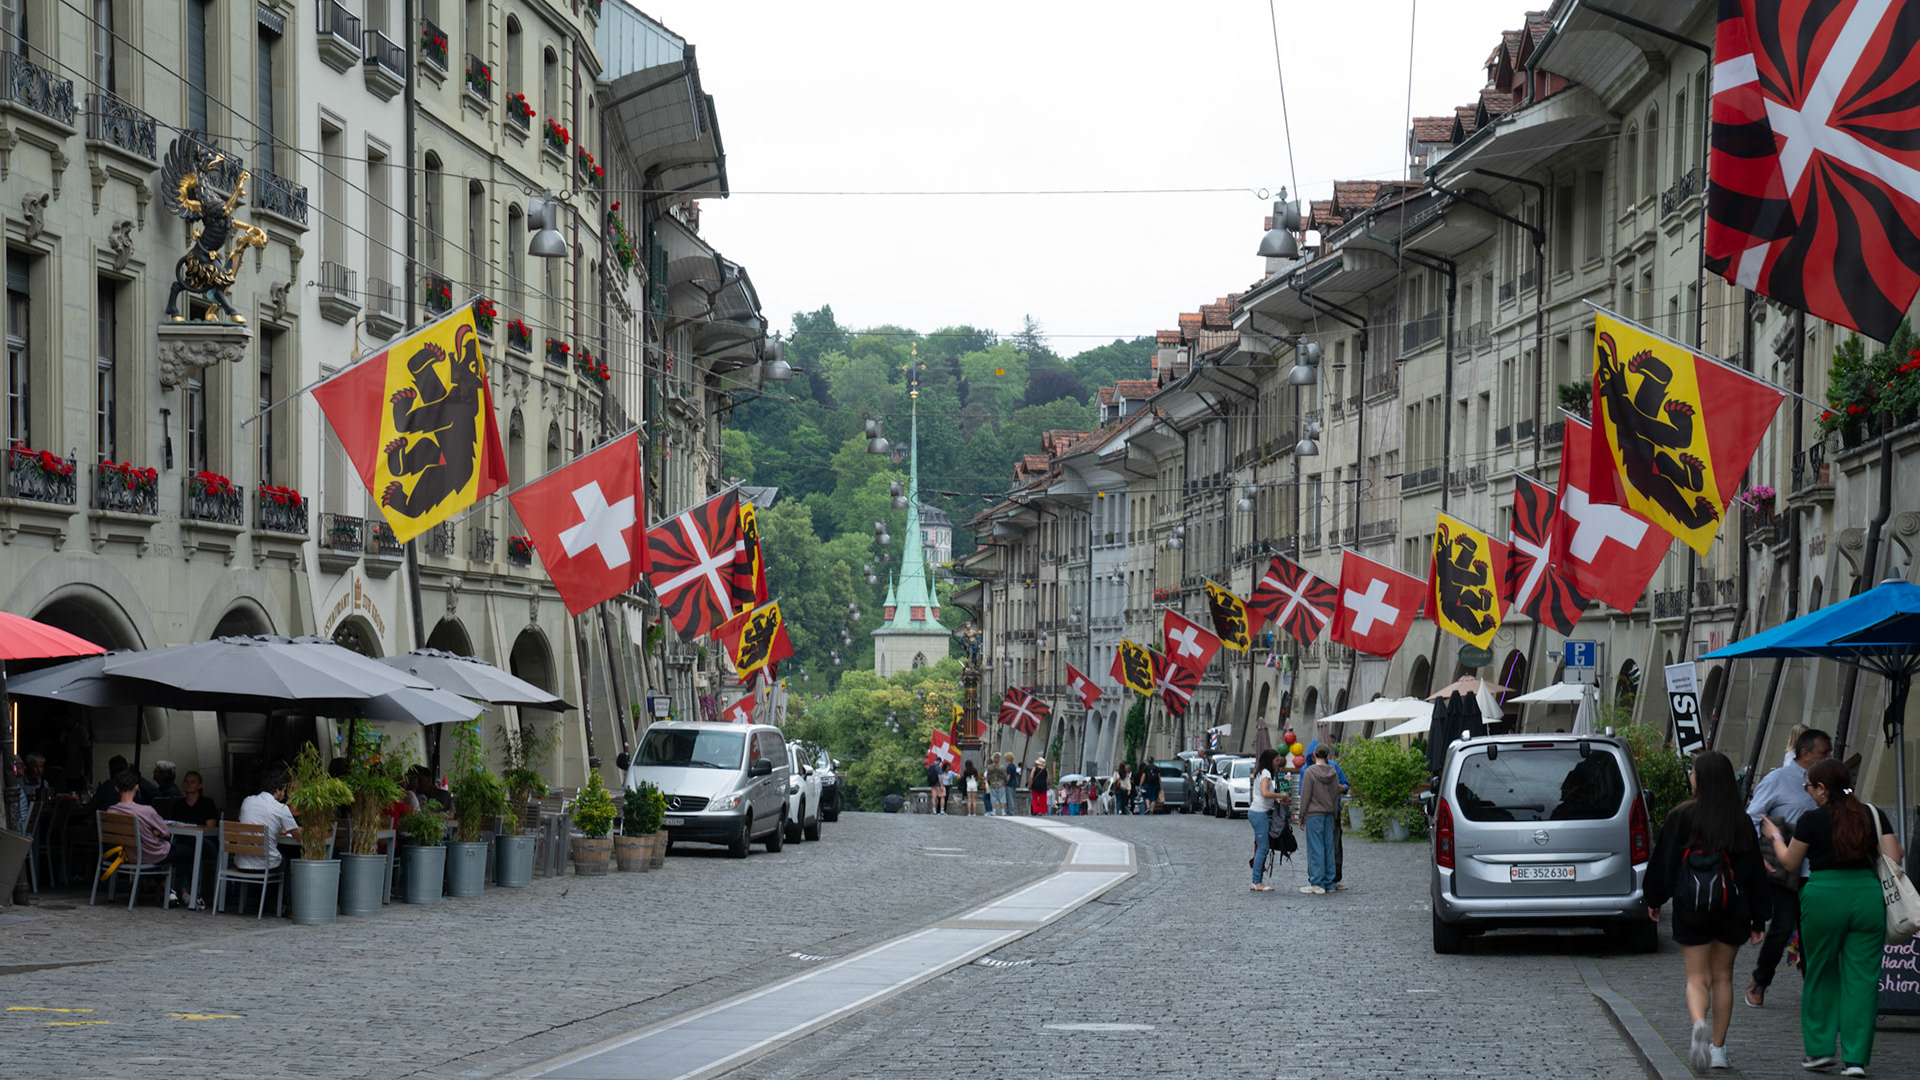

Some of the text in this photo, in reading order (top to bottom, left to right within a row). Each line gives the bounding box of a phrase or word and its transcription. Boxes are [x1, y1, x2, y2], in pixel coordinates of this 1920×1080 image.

[1574, 643, 1586, 655] P
[1884, 939, 1920, 955] ond
[1881, 955, 1920, 973] Hand
[1878, 973, 1920, 994] shion
